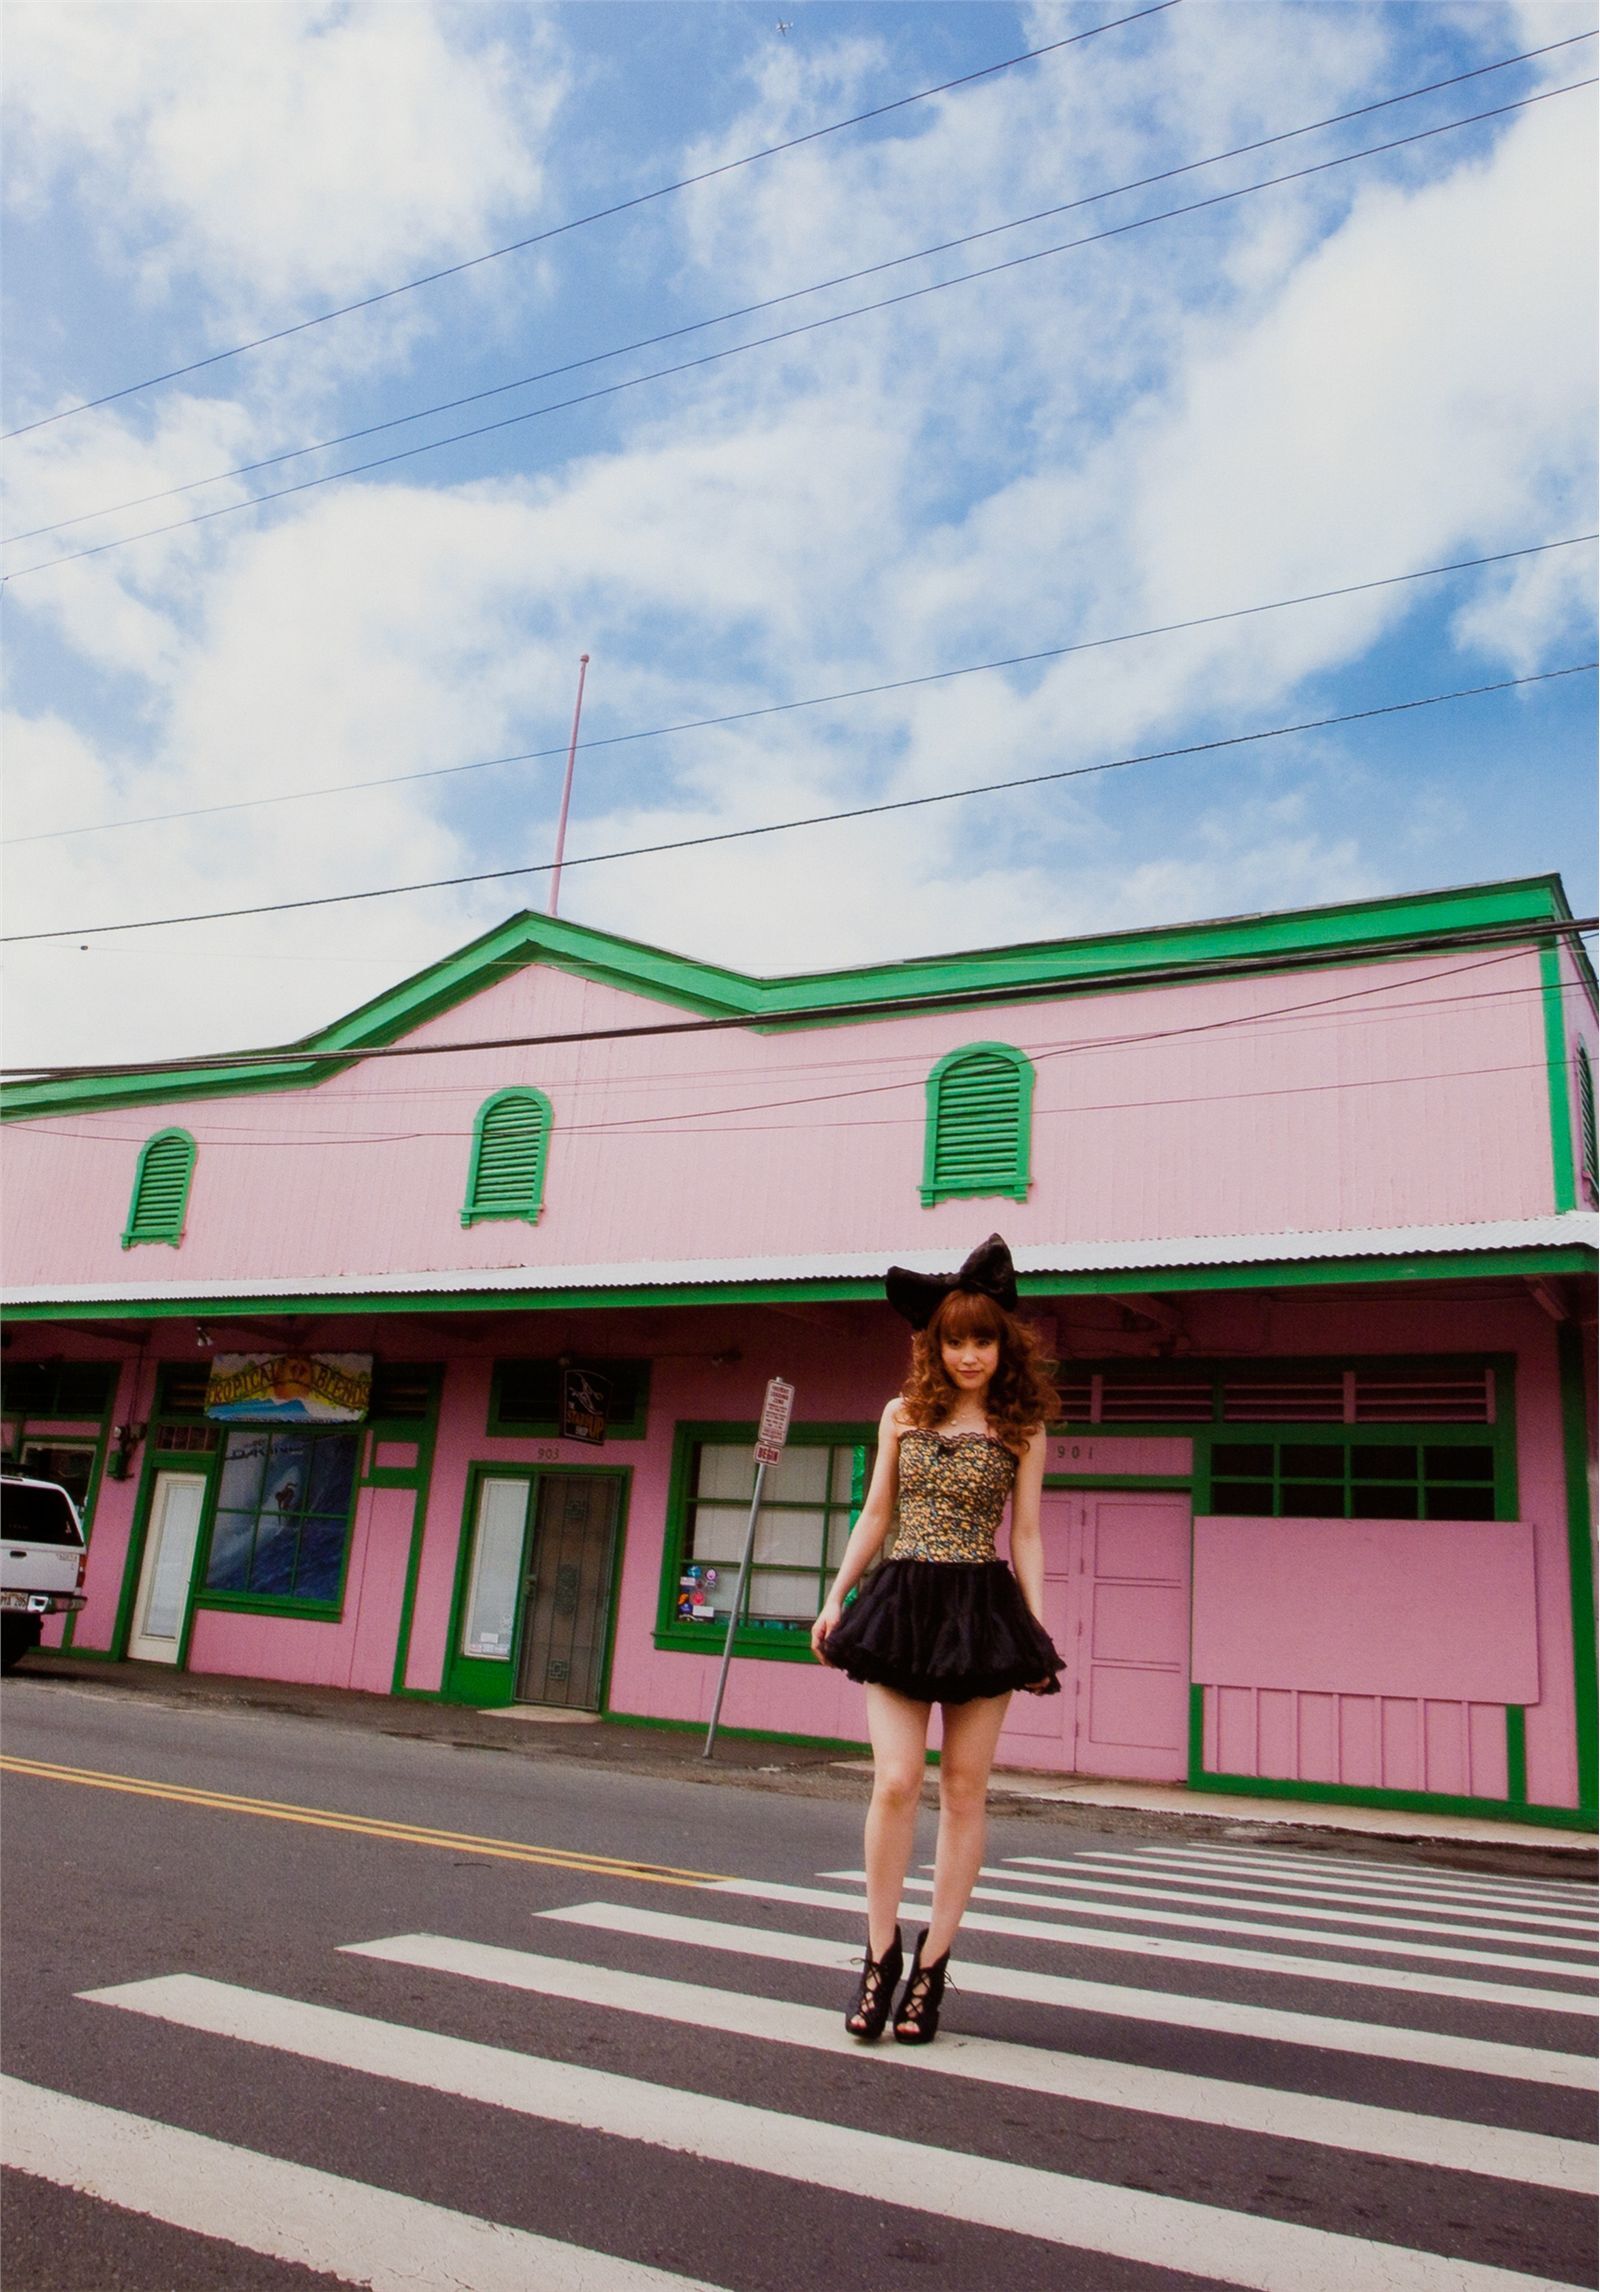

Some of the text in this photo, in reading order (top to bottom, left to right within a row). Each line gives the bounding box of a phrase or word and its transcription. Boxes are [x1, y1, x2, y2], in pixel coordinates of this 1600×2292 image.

[205, 1361, 369, 1405] TROPICAL BLENDS
[537, 1447, 560, 1460] 903
[1057, 1445, 1093, 1460] 901
